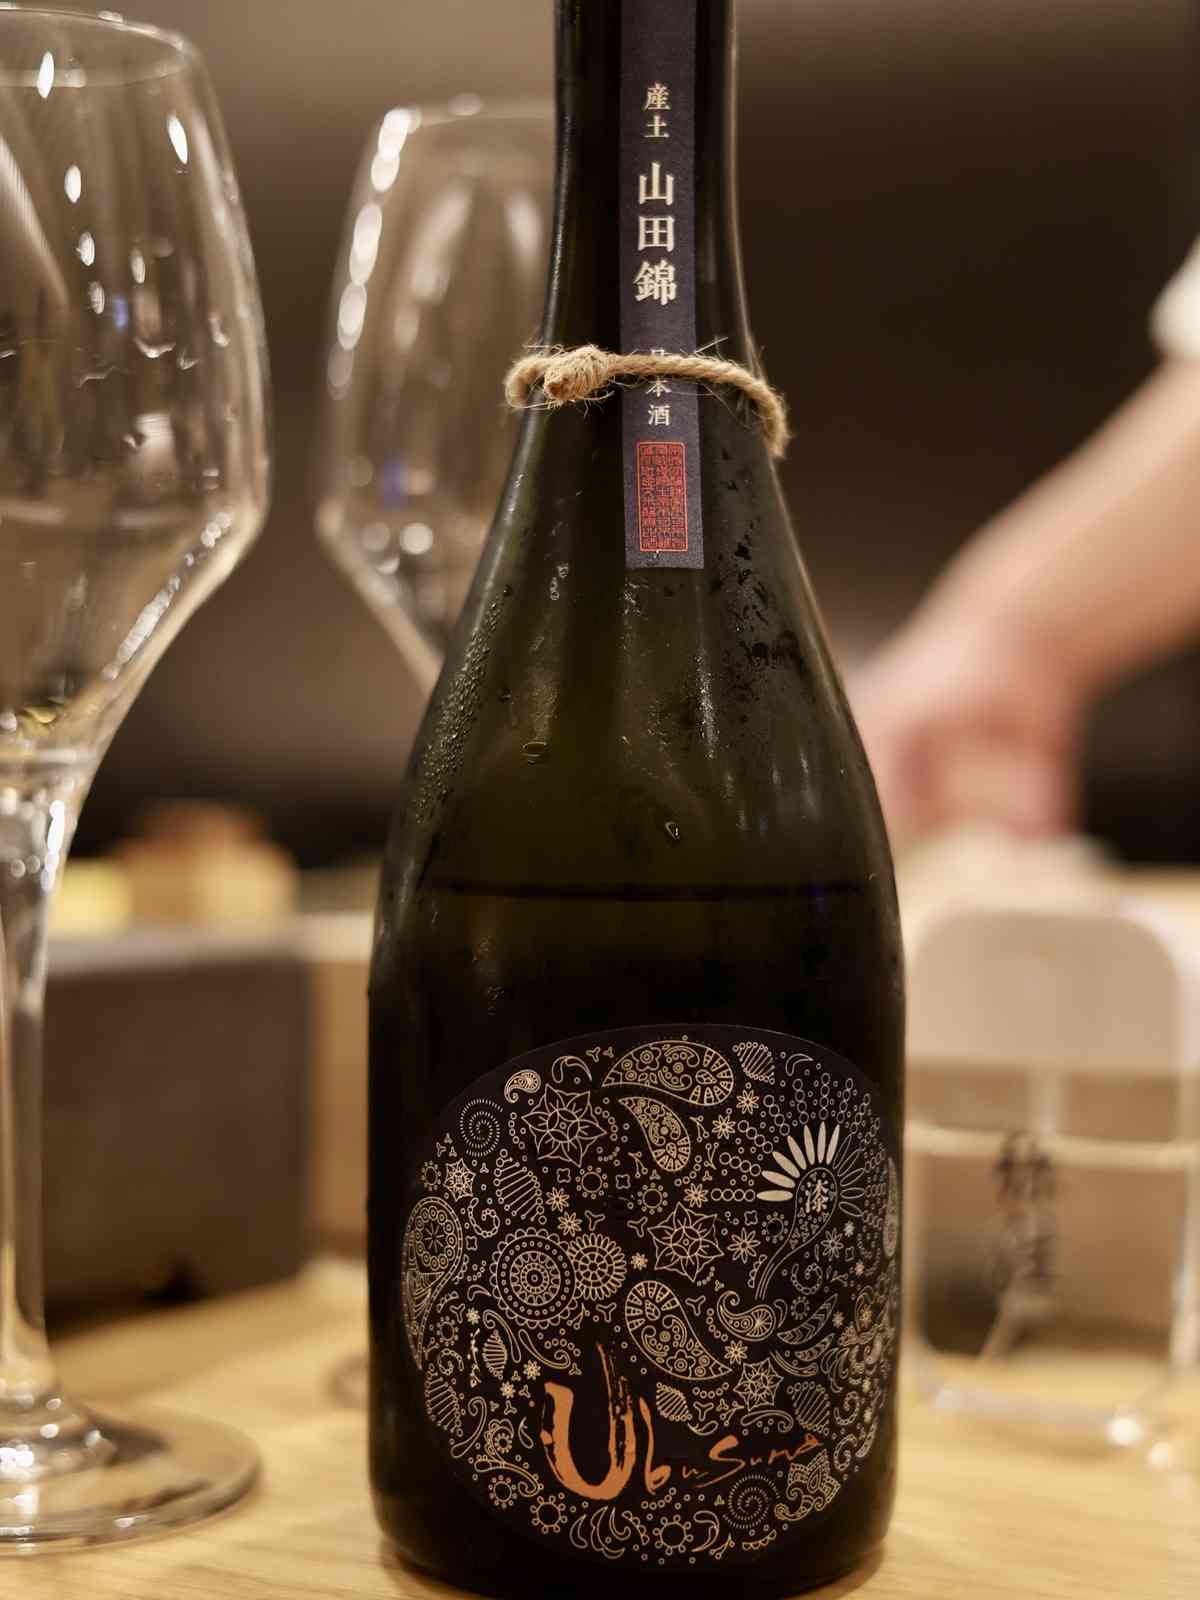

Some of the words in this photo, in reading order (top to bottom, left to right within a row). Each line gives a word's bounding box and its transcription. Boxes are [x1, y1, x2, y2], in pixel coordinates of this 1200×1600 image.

[644, 83, 671, 138] 産土
[633, 161, 678, 306] 山田錦
[646, 349, 672, 426] 本酒
